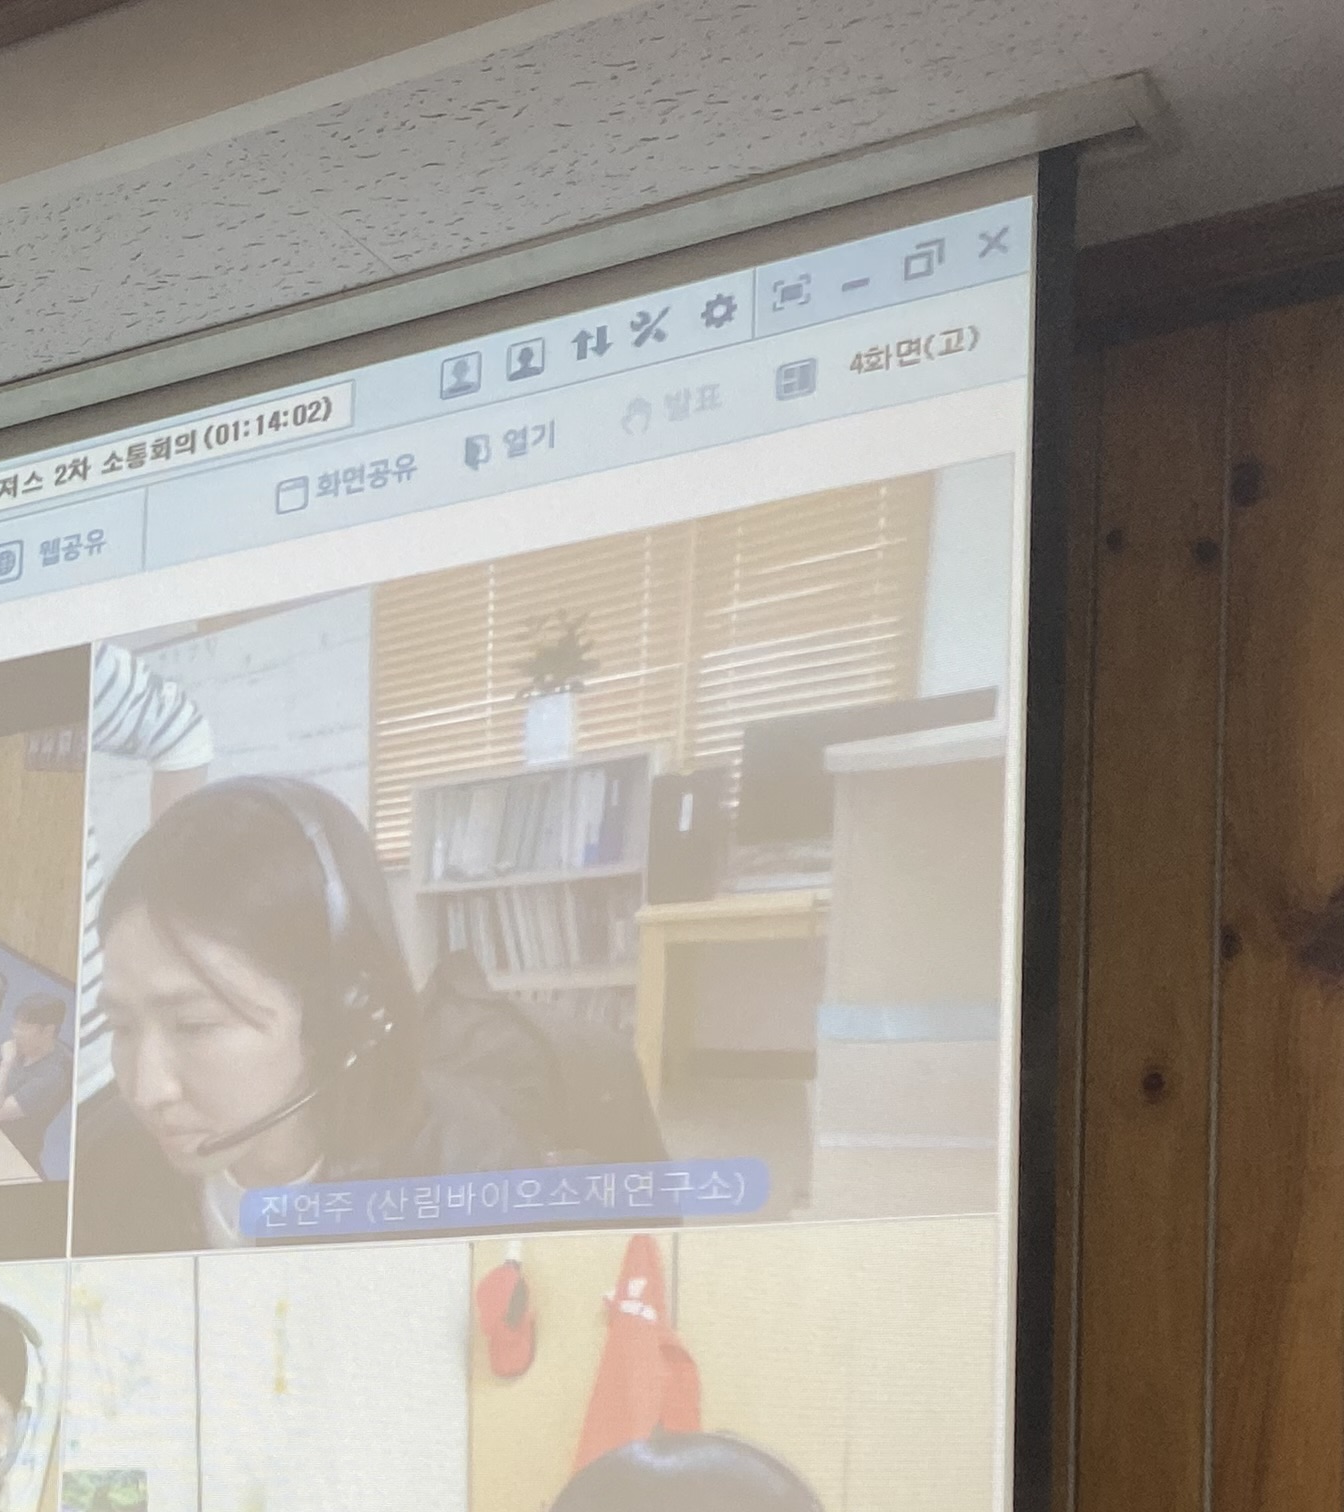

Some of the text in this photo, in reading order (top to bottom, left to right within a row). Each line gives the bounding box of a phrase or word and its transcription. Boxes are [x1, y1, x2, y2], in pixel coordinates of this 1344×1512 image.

[850, 324, 981, 377] 4화면(고)
[502, 420, 557, 460] 열기
[55, 457, 91, 486] 2차
[316, 451, 418, 499] 화면공유
[39, 528, 107, 568] 웹공유
[260, 1170, 746, 1227] 진언주 (산림바이오소재연구소)
